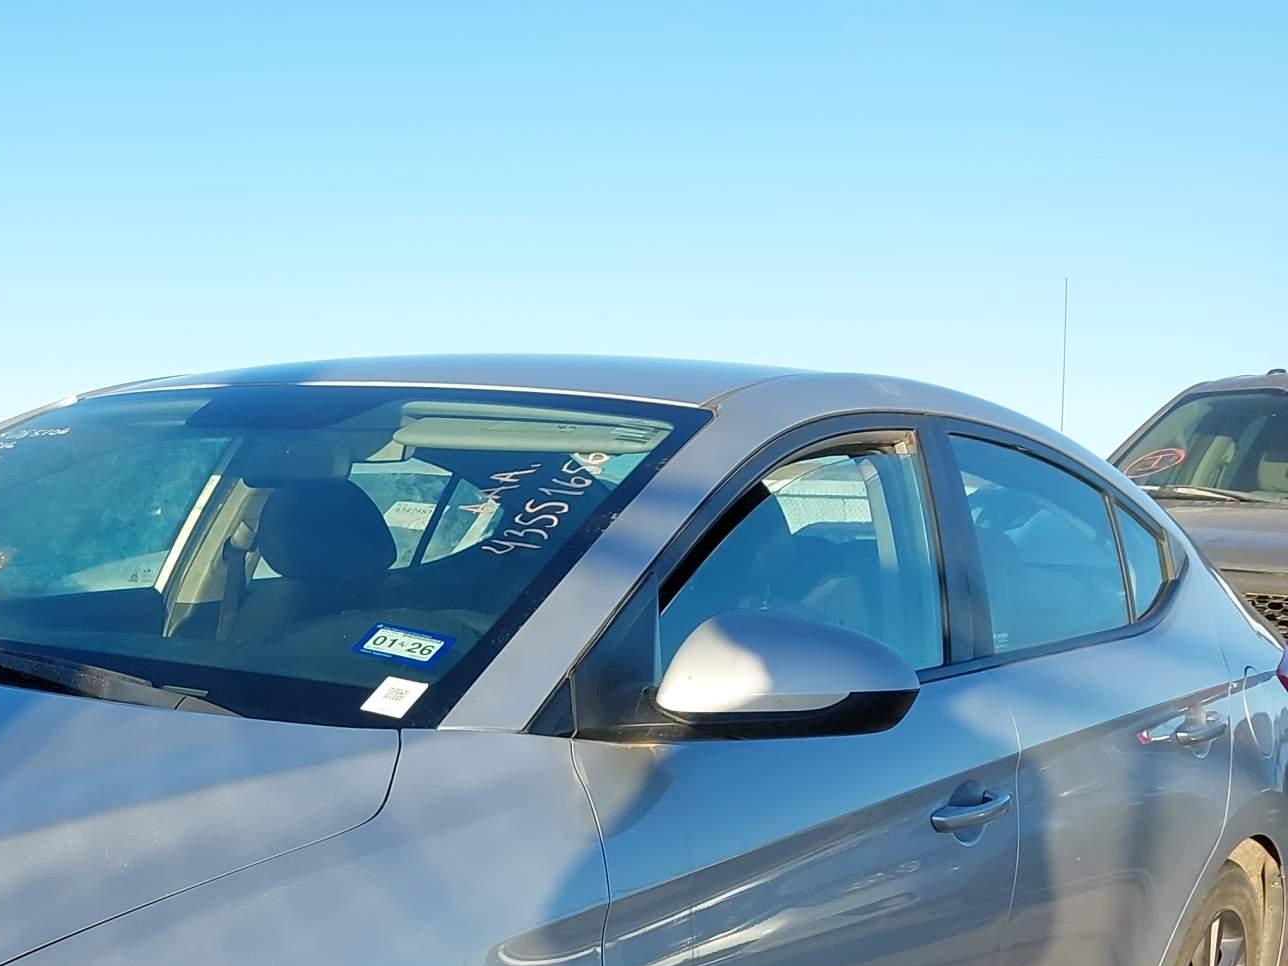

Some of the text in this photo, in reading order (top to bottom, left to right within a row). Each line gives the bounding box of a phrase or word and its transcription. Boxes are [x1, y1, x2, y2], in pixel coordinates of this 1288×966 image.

[482, 452, 610, 555] 43551656
[372, 635, 397, 648] 01
[407, 642, 436, 656] 26
